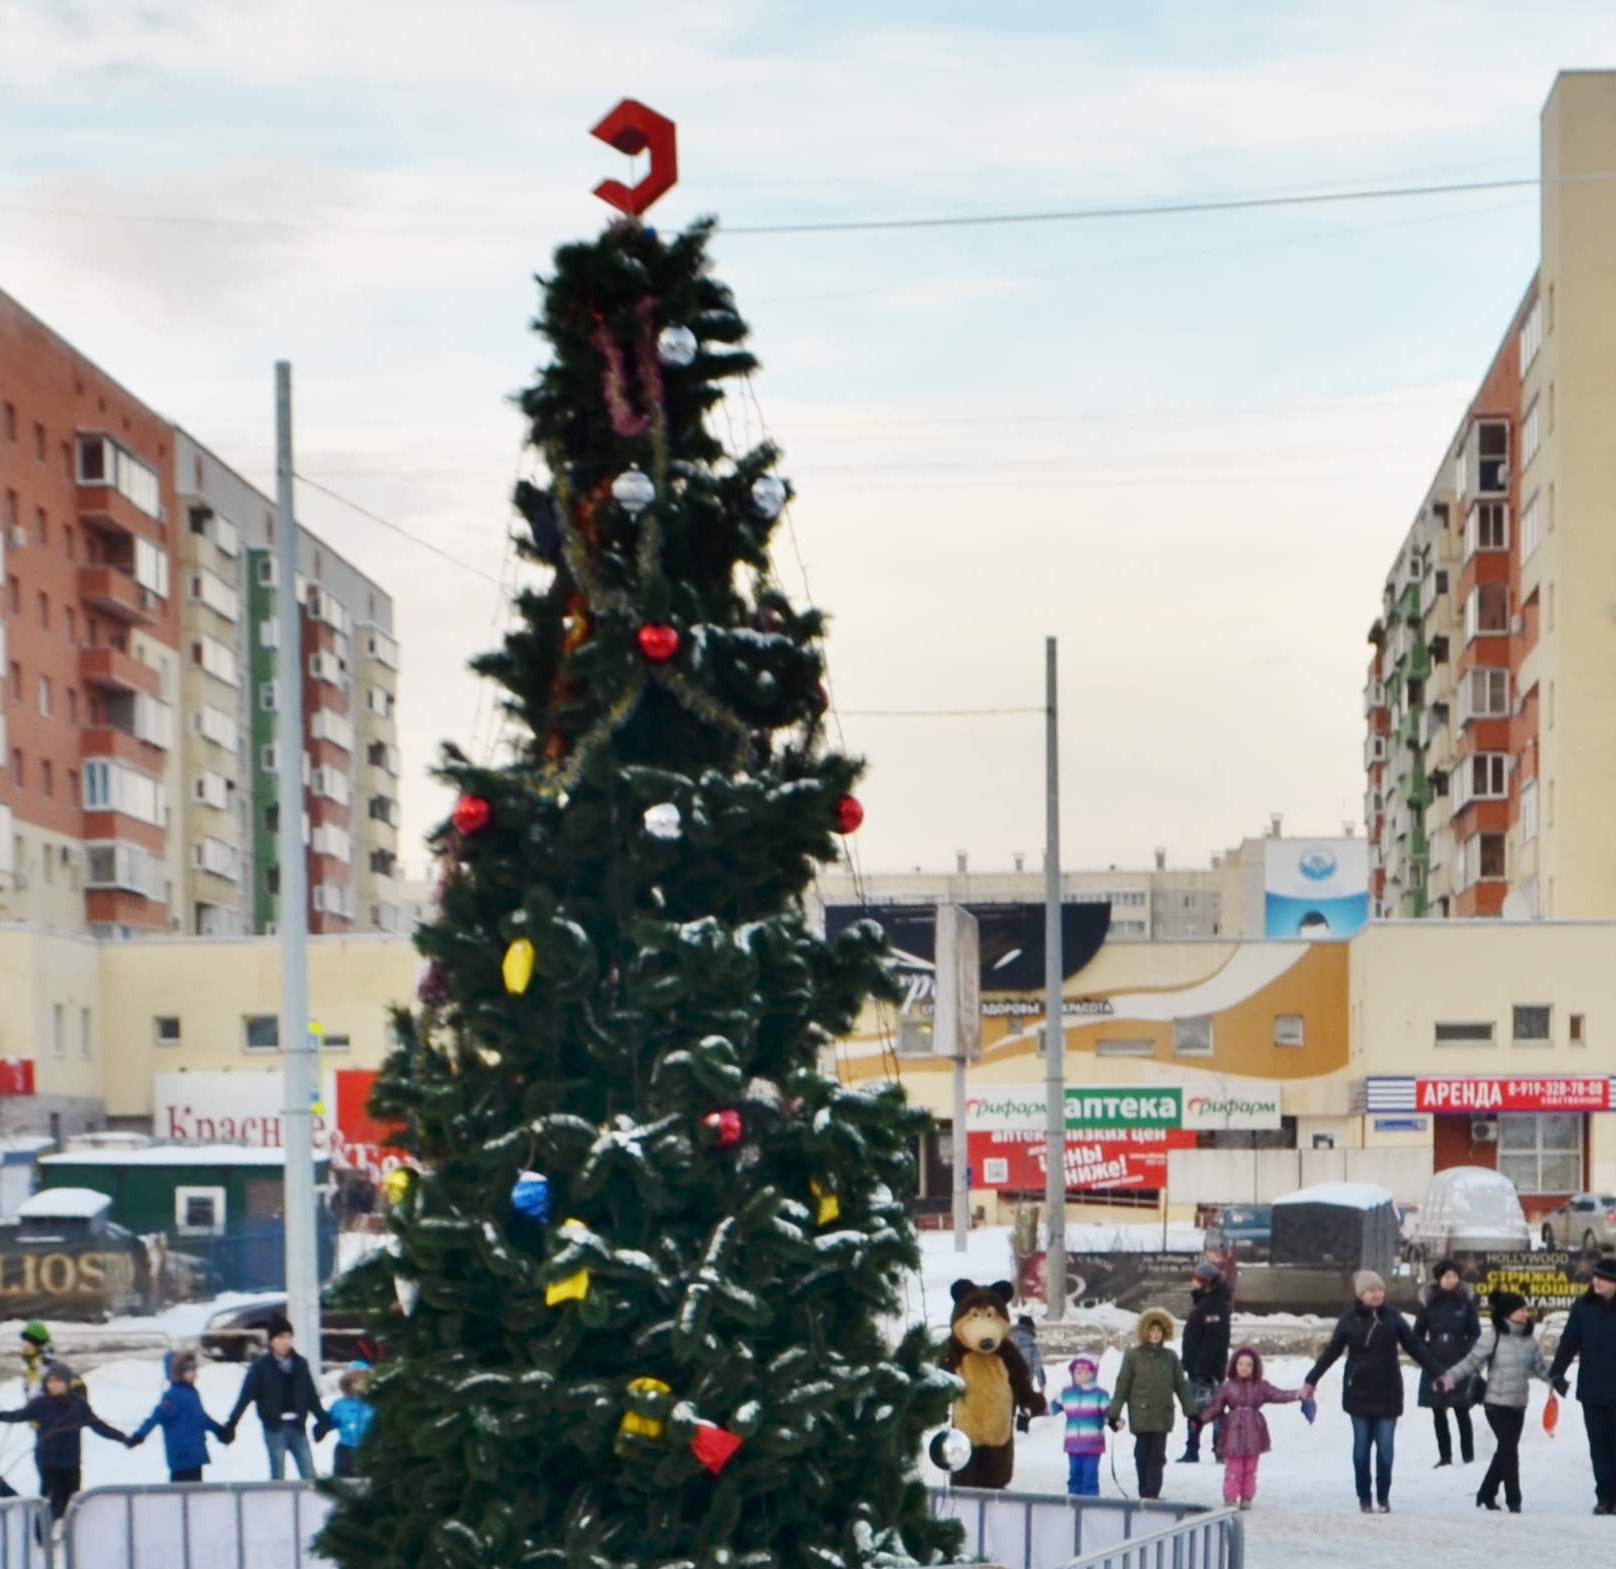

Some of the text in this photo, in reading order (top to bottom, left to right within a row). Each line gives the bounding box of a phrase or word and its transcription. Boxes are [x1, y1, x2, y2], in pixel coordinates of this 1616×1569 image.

[981, 1001, 1041, 1014] ЗДОРОВЬЕ
[1423, 1082, 1503, 1108] АРЕНДА
[1065, 1095, 1177, 1119] аптека
[167, 1105, 325, 1148] Красне
[1487, 1253, 1569, 1264] HOLLYWOOD
[1487, 1271, 1567, 1282] СТРИЖКА
